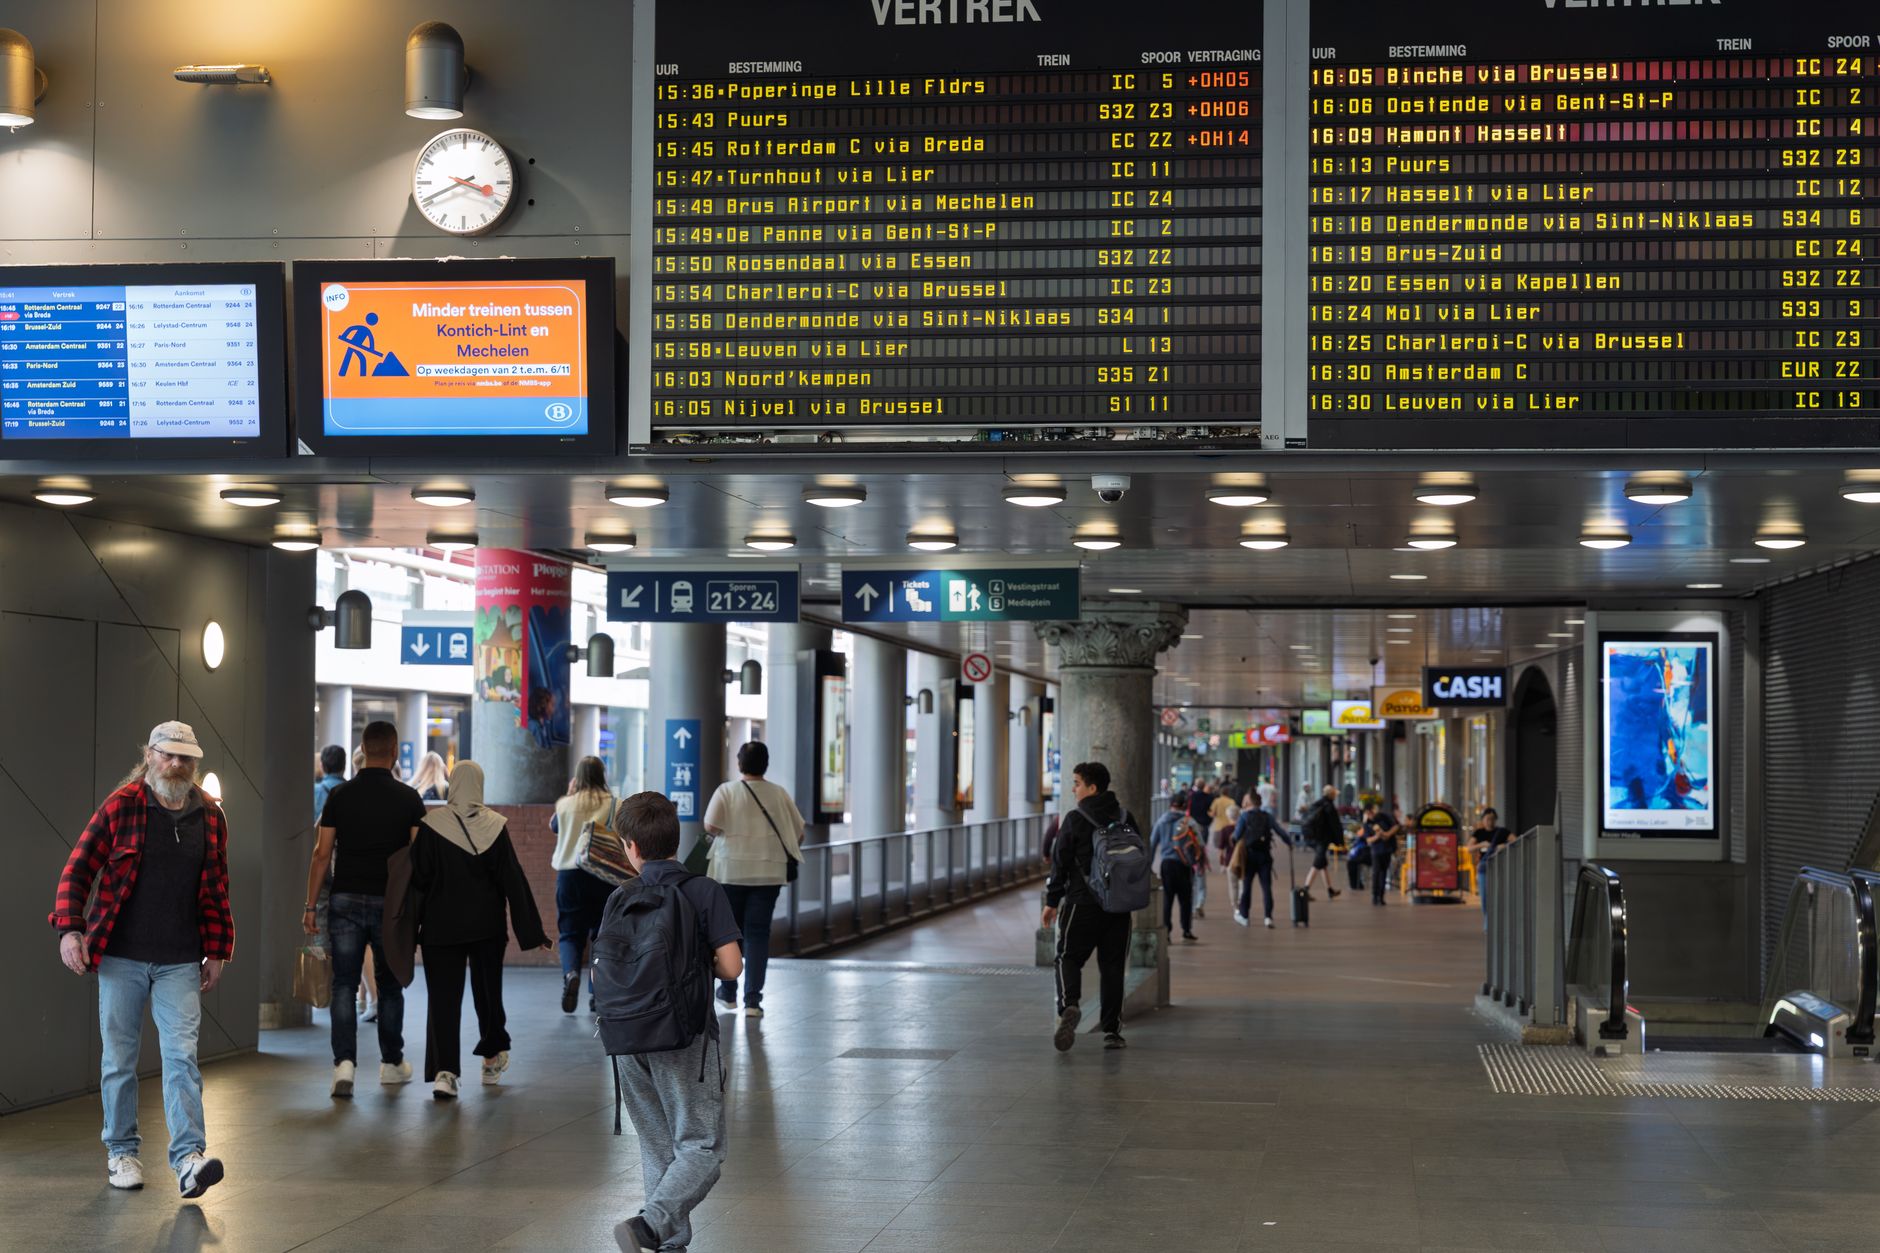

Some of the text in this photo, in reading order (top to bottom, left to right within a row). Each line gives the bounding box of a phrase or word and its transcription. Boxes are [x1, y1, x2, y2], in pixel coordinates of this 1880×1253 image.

[871, 0, 1042, 25] VERTREK
[1717, 39, 1752, 50] TREIN
[1827, 36, 1870, 48] SPOOR
[1141, 52, 1181, 63] SPOOR
[1188, 50, 1261, 62] VERTRAGING
[1312, 48, 1336, 59] UUR
[1389, 45, 1466, 57] BESTEMMING
[1037, 54, 1070, 66] TREIN
[656, 64, 679, 75] UUR
[729, 61, 802, 73] BESTEMMING
[1313, 58, 1860, 84] 16:05 Binche via Brussel IC 24
[659, 72, 1248, 100] 15:36 Poperinge Lille Fldrs IC 5 +0H05
[1313, 89, 1861, 114] 16:06 Oostende via Gent-St-P IC 2
[659, 101, 1248, 128] 15:43 Puurs S32 23 +0H06
[1313, 119, 1861, 143] 16:09 Hamont Hasselt IC 4
[658, 131, 1248, 156] 15:45 Rotterdam C via Breda EC 22 +0H14
[657, 191, 1171, 214] 15:49 Brus Airport via Mechelen IC 24
[1312, 210, 1861, 232] 16:18 Dendermonde via Sint-Niklaas S34 6
[1312, 270, 1860, 291] 16:20 Essen via Kapellen S32 22
[326, 293, 346, 302] INFO
[412, 303, 572, 317] Minder treinen tussen
[656, 308, 1169, 329] 15:56 Dendermonde via Sint-Niklaas S34 1
[437, 323, 549, 336] Kontich-Lint en
[457, 344, 529, 357] Mechelen
[418, 366, 431, 375] Op
[435, 366, 489, 376] weekdagen
[512, 366, 518, 374] 2
[520, 366, 548, 374] t.e.m.
[550, 365, 570, 375] 6/11
[656, 367, 1167, 387] 16:03 Noord'kempen S35 21
[1312, 362, 1859, 380] 16:30 Amsterdam C EUR 22
[729, 583, 756, 592] Sporen
[903, 581, 930, 589] Tickets
[993, 583, 1060, 592] 4 Vestingstraat
[711, 592, 775, 610] 21 24
[994, 599, 1051, 608] 5 Mediaplein
[1433, 676, 1501, 698] CASH
